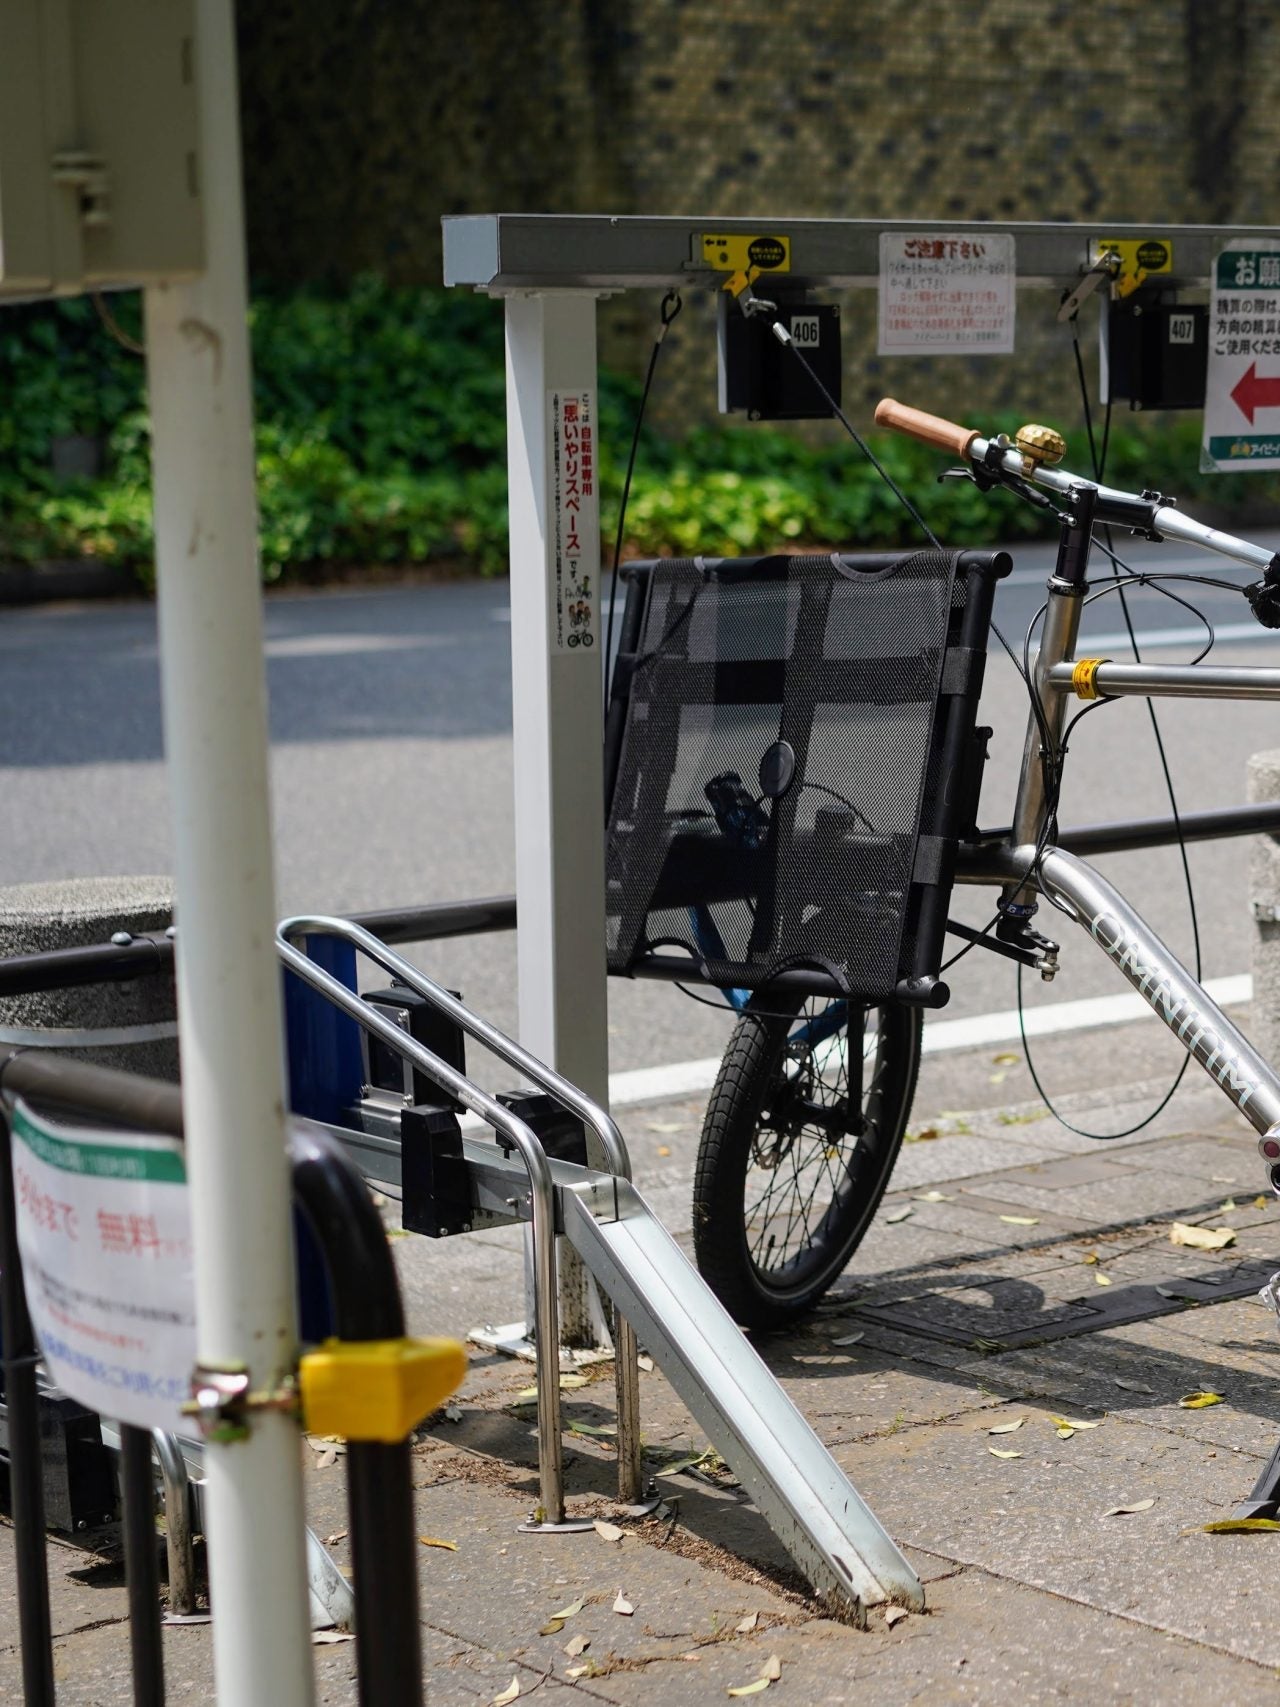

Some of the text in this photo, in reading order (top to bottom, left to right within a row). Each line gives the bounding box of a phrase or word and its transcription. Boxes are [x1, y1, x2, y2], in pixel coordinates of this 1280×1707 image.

[904, 239, 986, 260] ご注意下さい
[793, 322, 818, 343] 406
[1172, 320, 1193, 339] 407
[581, 426, 593, 497] 自転車専用
[1092, 911, 1256, 1108] OMNIUM
